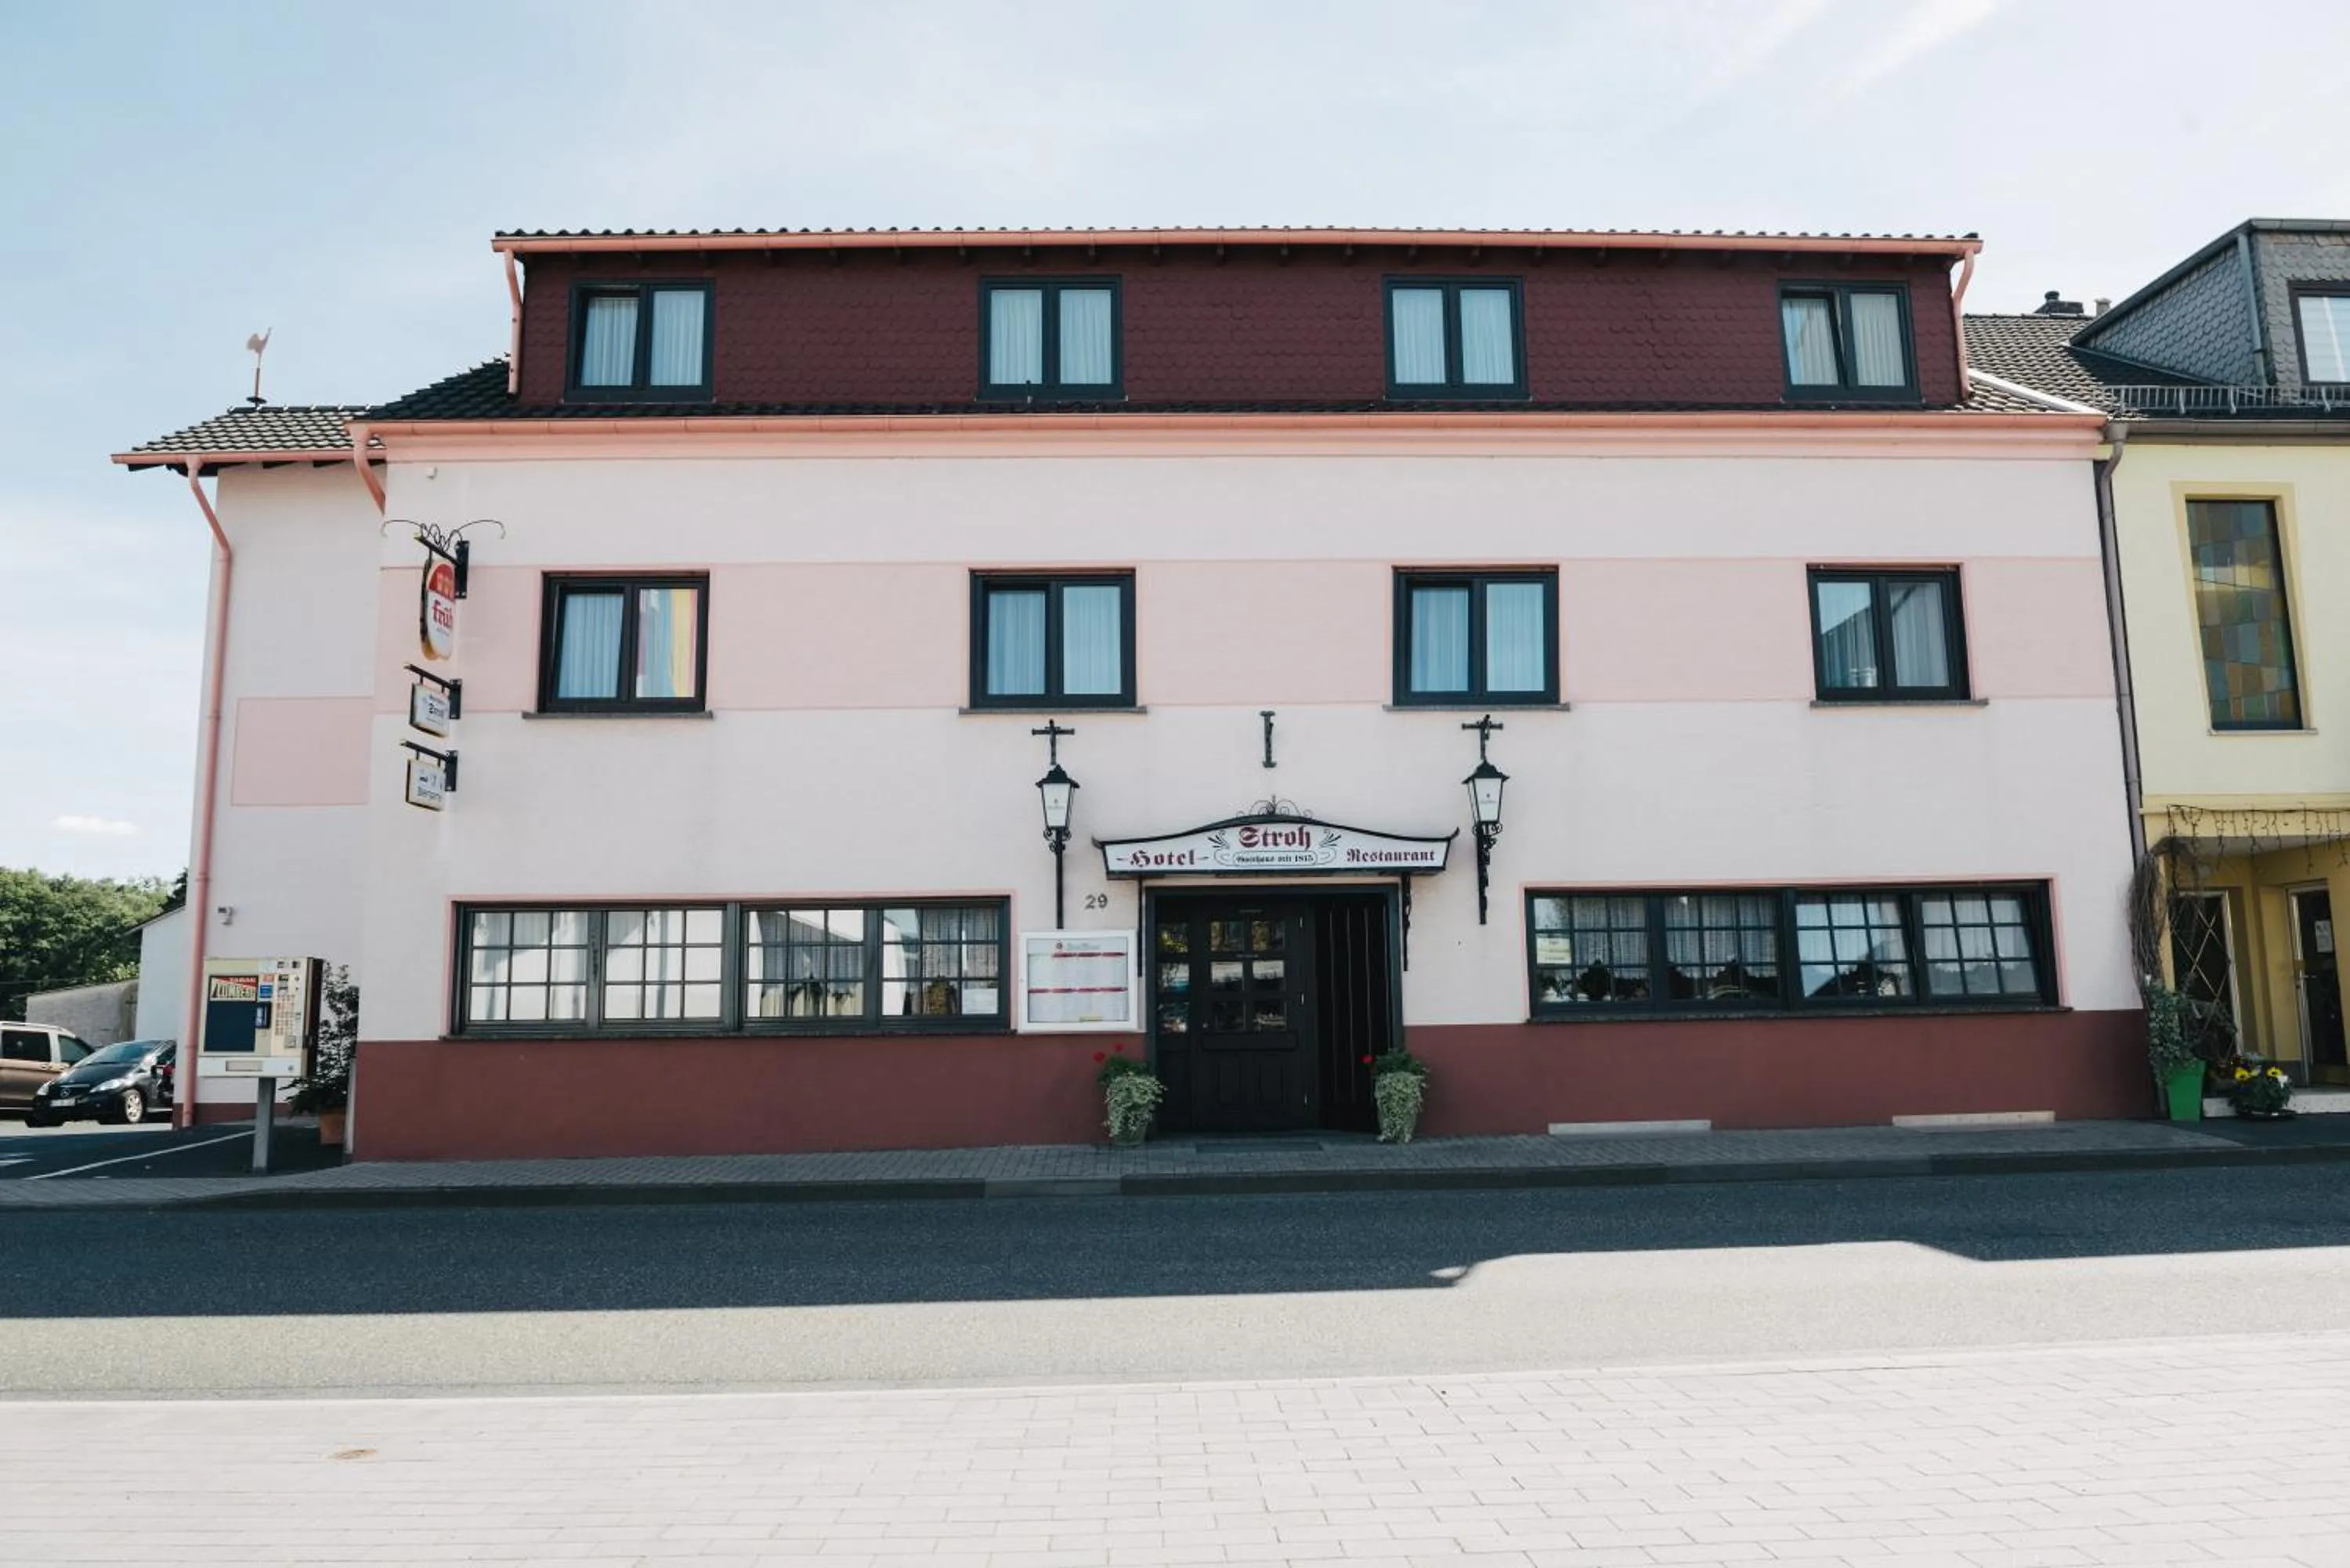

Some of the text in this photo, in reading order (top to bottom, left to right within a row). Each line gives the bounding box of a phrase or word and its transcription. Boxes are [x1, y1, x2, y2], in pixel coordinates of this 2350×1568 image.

[1238, 826, 1311, 851] Stroh
[1130, 850, 1195, 867] Hotel
[1346, 847, 1435, 862] Restaurant
[1085, 893, 1108, 909] 29
